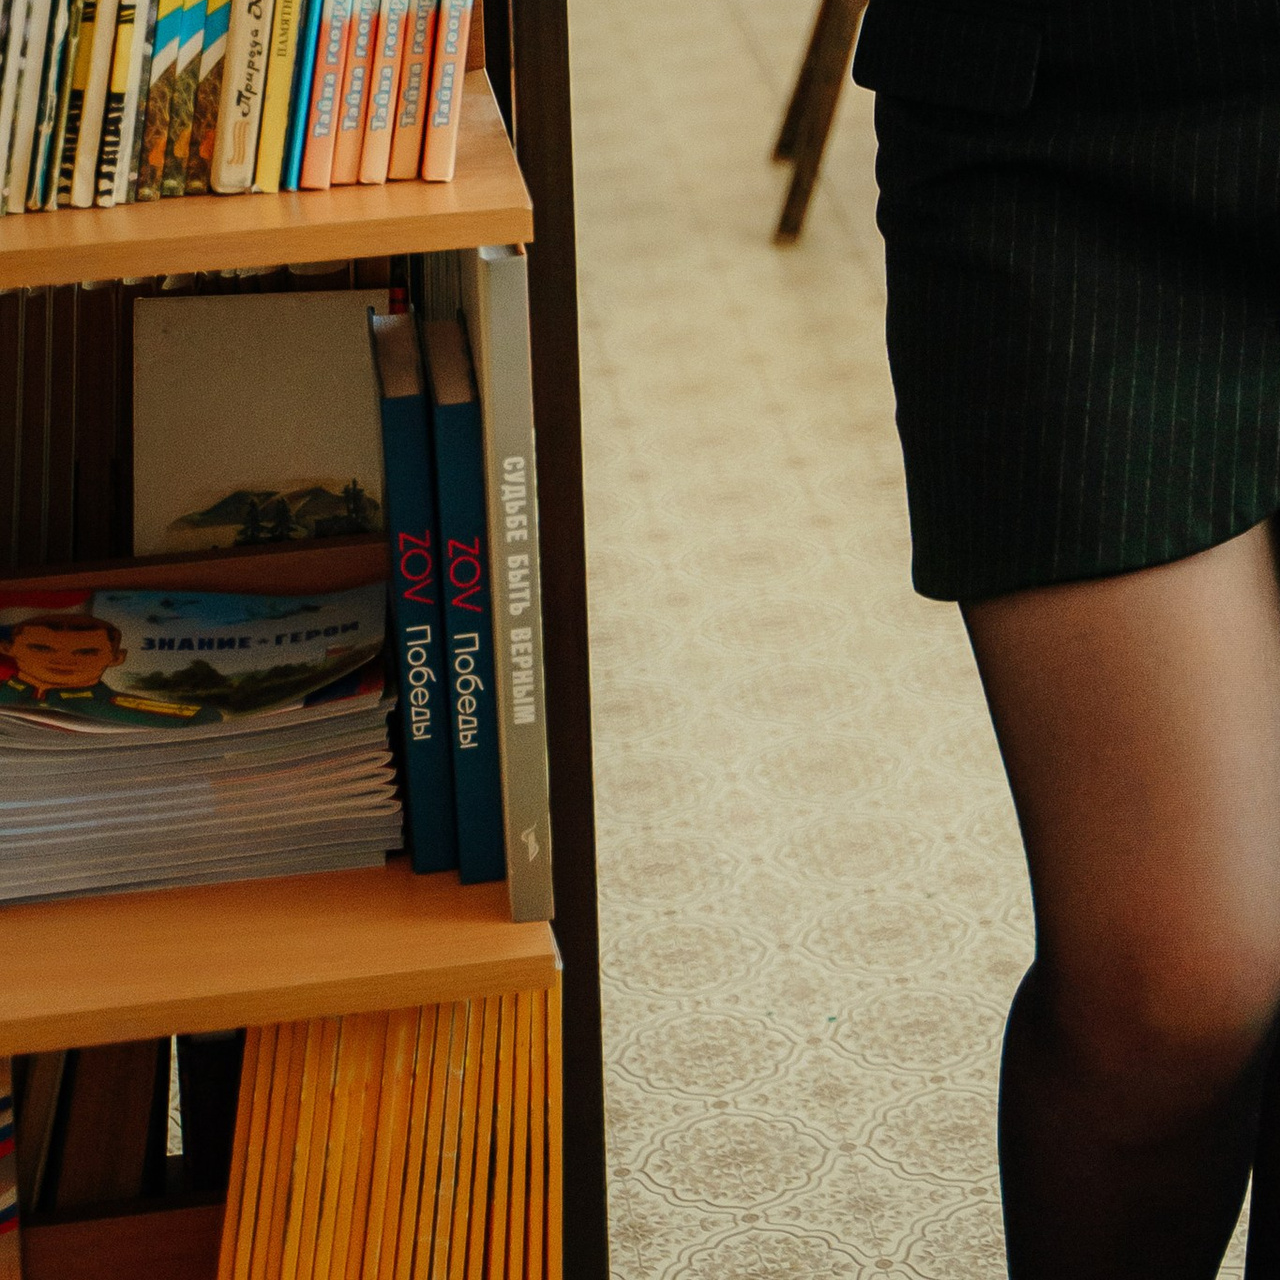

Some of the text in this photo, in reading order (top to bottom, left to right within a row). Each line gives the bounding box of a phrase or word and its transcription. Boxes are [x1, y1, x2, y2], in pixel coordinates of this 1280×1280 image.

[235, 29, 262, 118] Природа
[313, 72, 337, 138] Тайна
[342, 66, 365, 131] Тайна
[371, 66, 394, 131] Тайна
[400, 62, 424, 127] Тайна
[433, 62, 456, 126] Тайна
[503, 455, 535, 726] СУДЬБЕ БЫТЬ ВЕРНЫМ
[141, 636, 252, 651] ЗНАНИЕ
[399, 530, 437, 741] ZOV Победы
[448, 536, 485, 749] ZOV Победы
